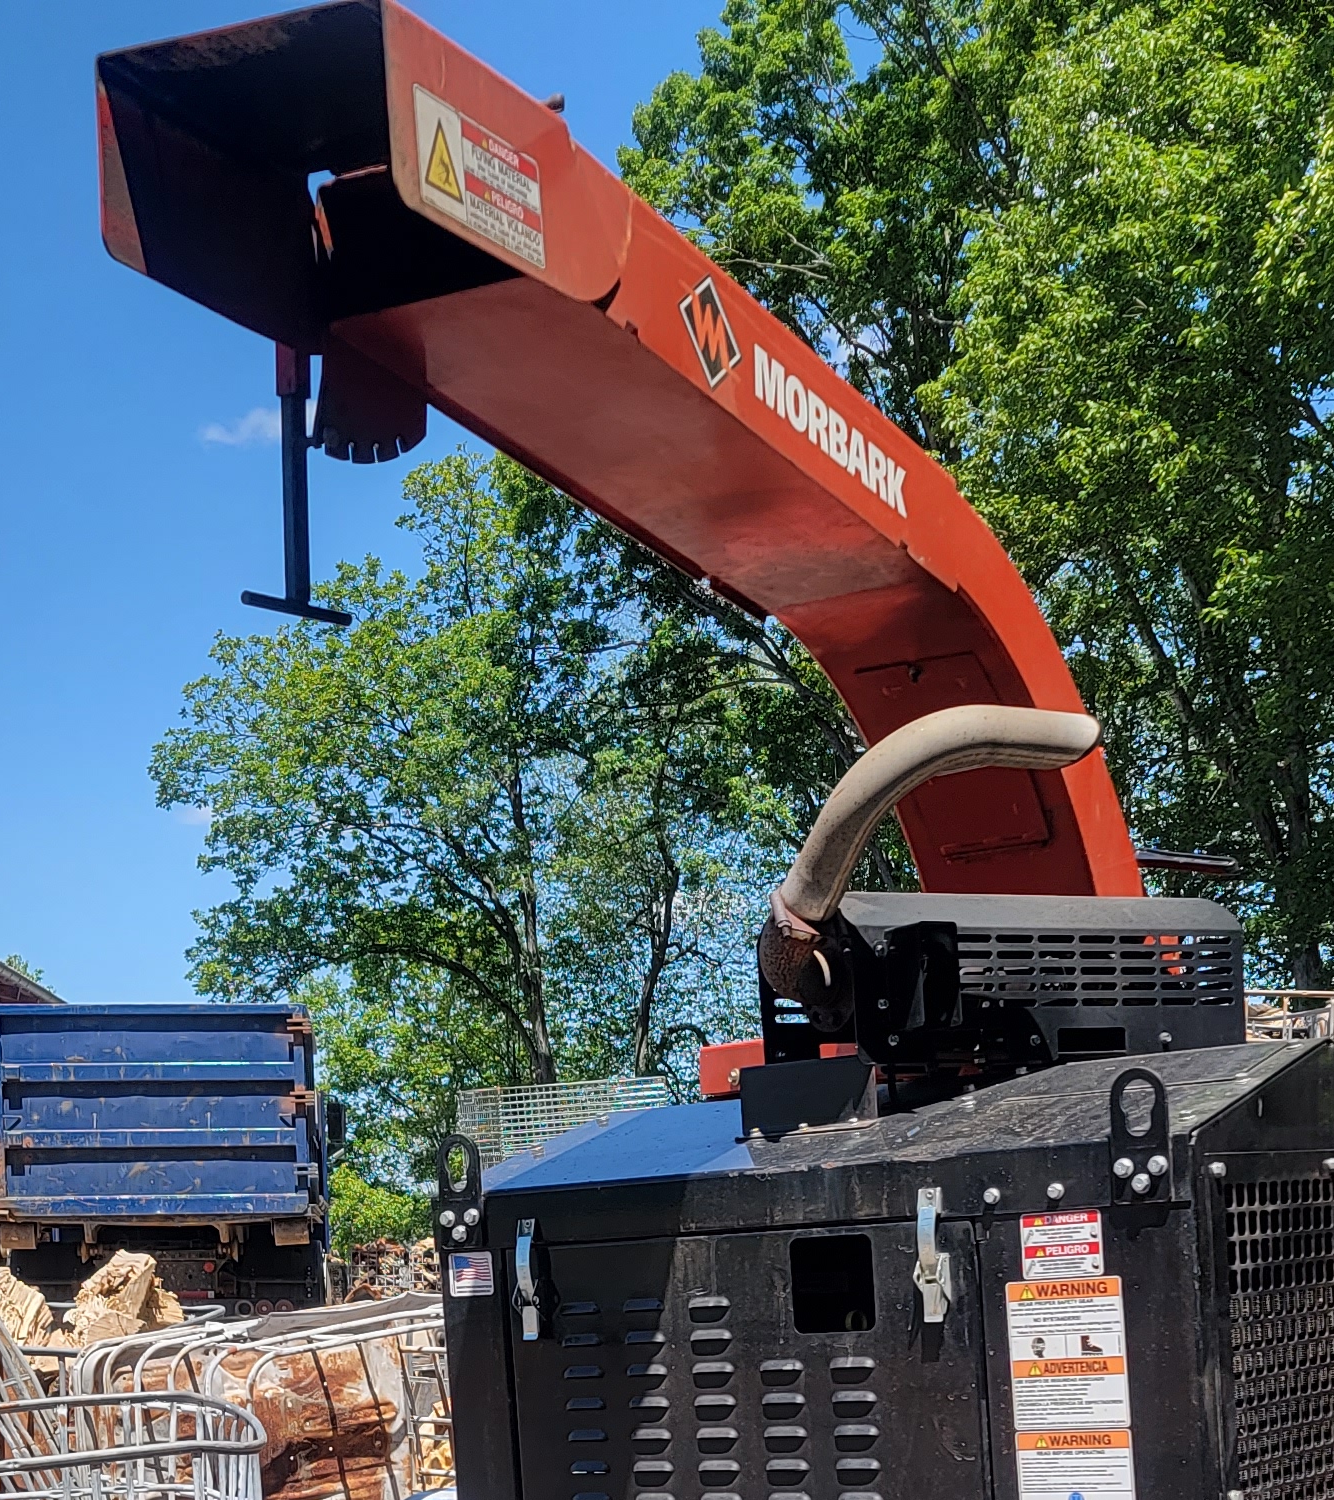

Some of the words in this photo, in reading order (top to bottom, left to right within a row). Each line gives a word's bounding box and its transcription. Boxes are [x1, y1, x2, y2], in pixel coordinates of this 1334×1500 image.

[488, 138, 519, 170] DANGER
[497, 160, 533, 193] MATERIAL
[469, 195, 505, 226] MATERIAL
[491, 190, 524, 221] PELIGRO
[754, 343, 908, 519] MORBARK
[1043, 1213, 1089, 1226] DANGER
[1045, 1244, 1090, 1256] PELIGRO
[1035, 1281, 1108, 1298] WARNING
[1043, 1360, 1109, 1375] ADVERTENCIA
[1048, 1434, 1112, 1446] WARNING
